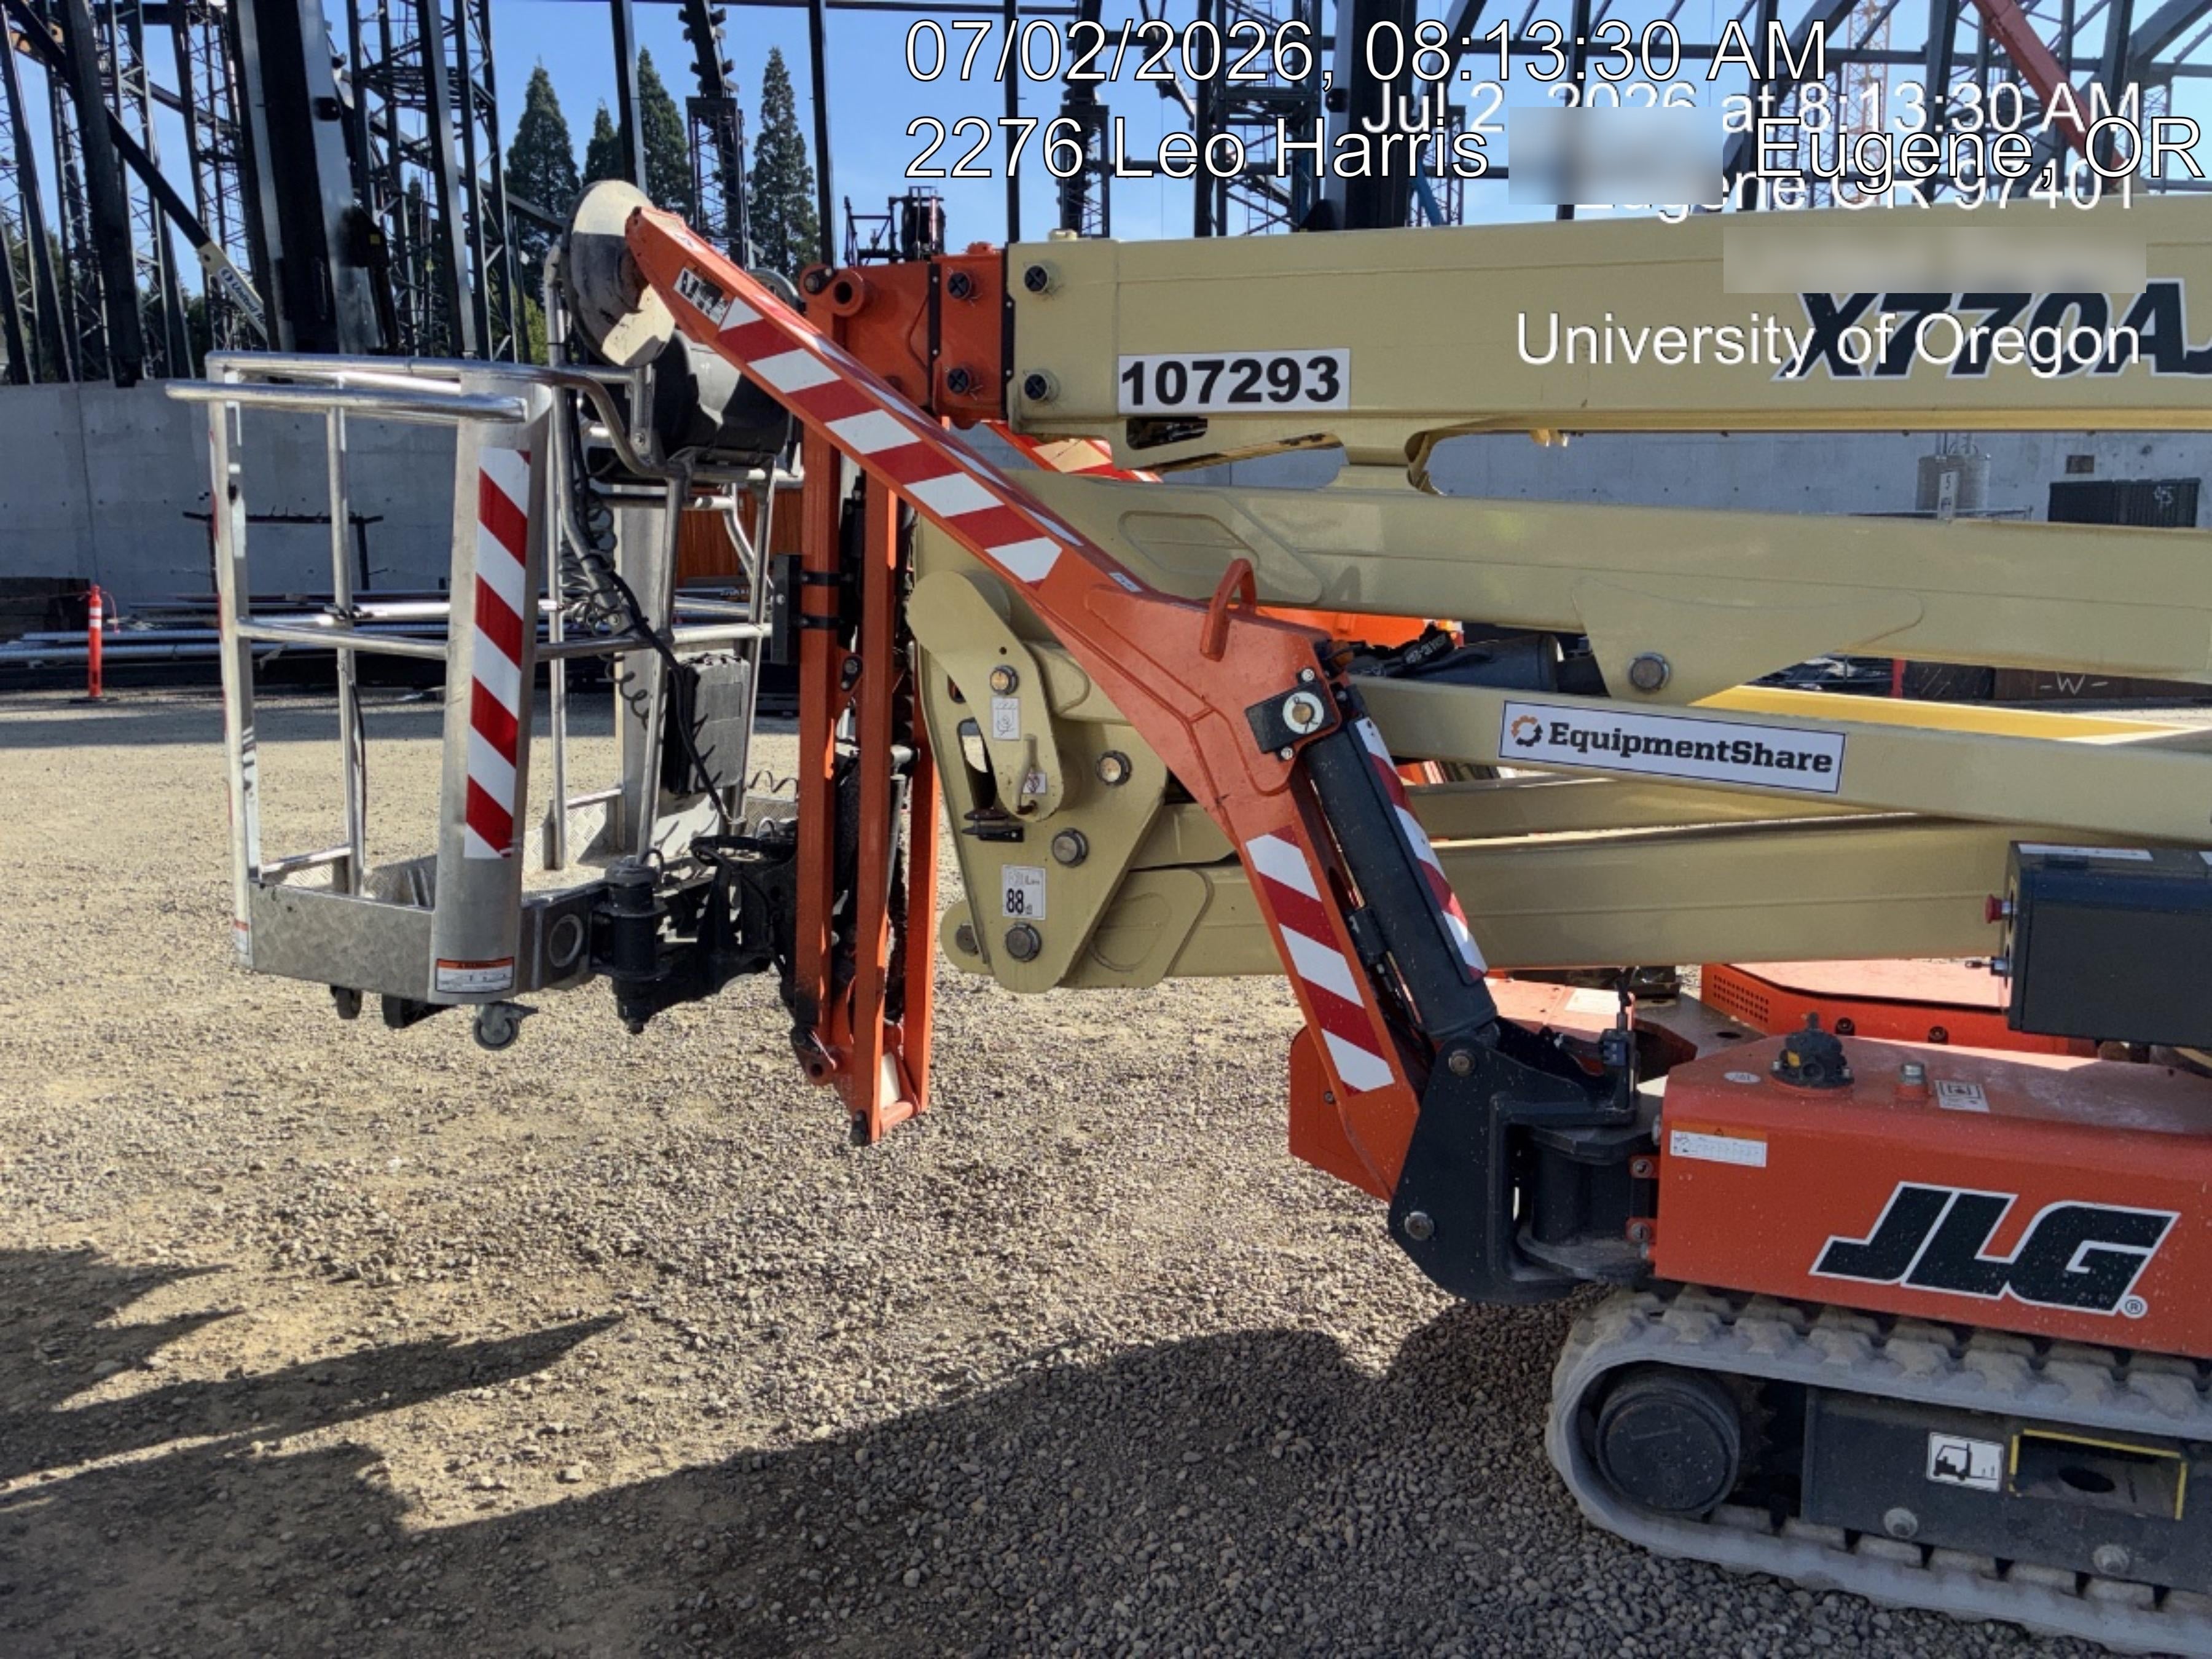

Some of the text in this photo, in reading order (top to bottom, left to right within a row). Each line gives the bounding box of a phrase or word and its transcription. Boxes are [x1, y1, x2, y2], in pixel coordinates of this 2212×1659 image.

[1771, 278, 2212, 382] X770A
[1121, 356, 1341, 406] 107293
[1548, 721, 1833, 773] EquipmentShare
[1006, 888, 1024, 914] 88
